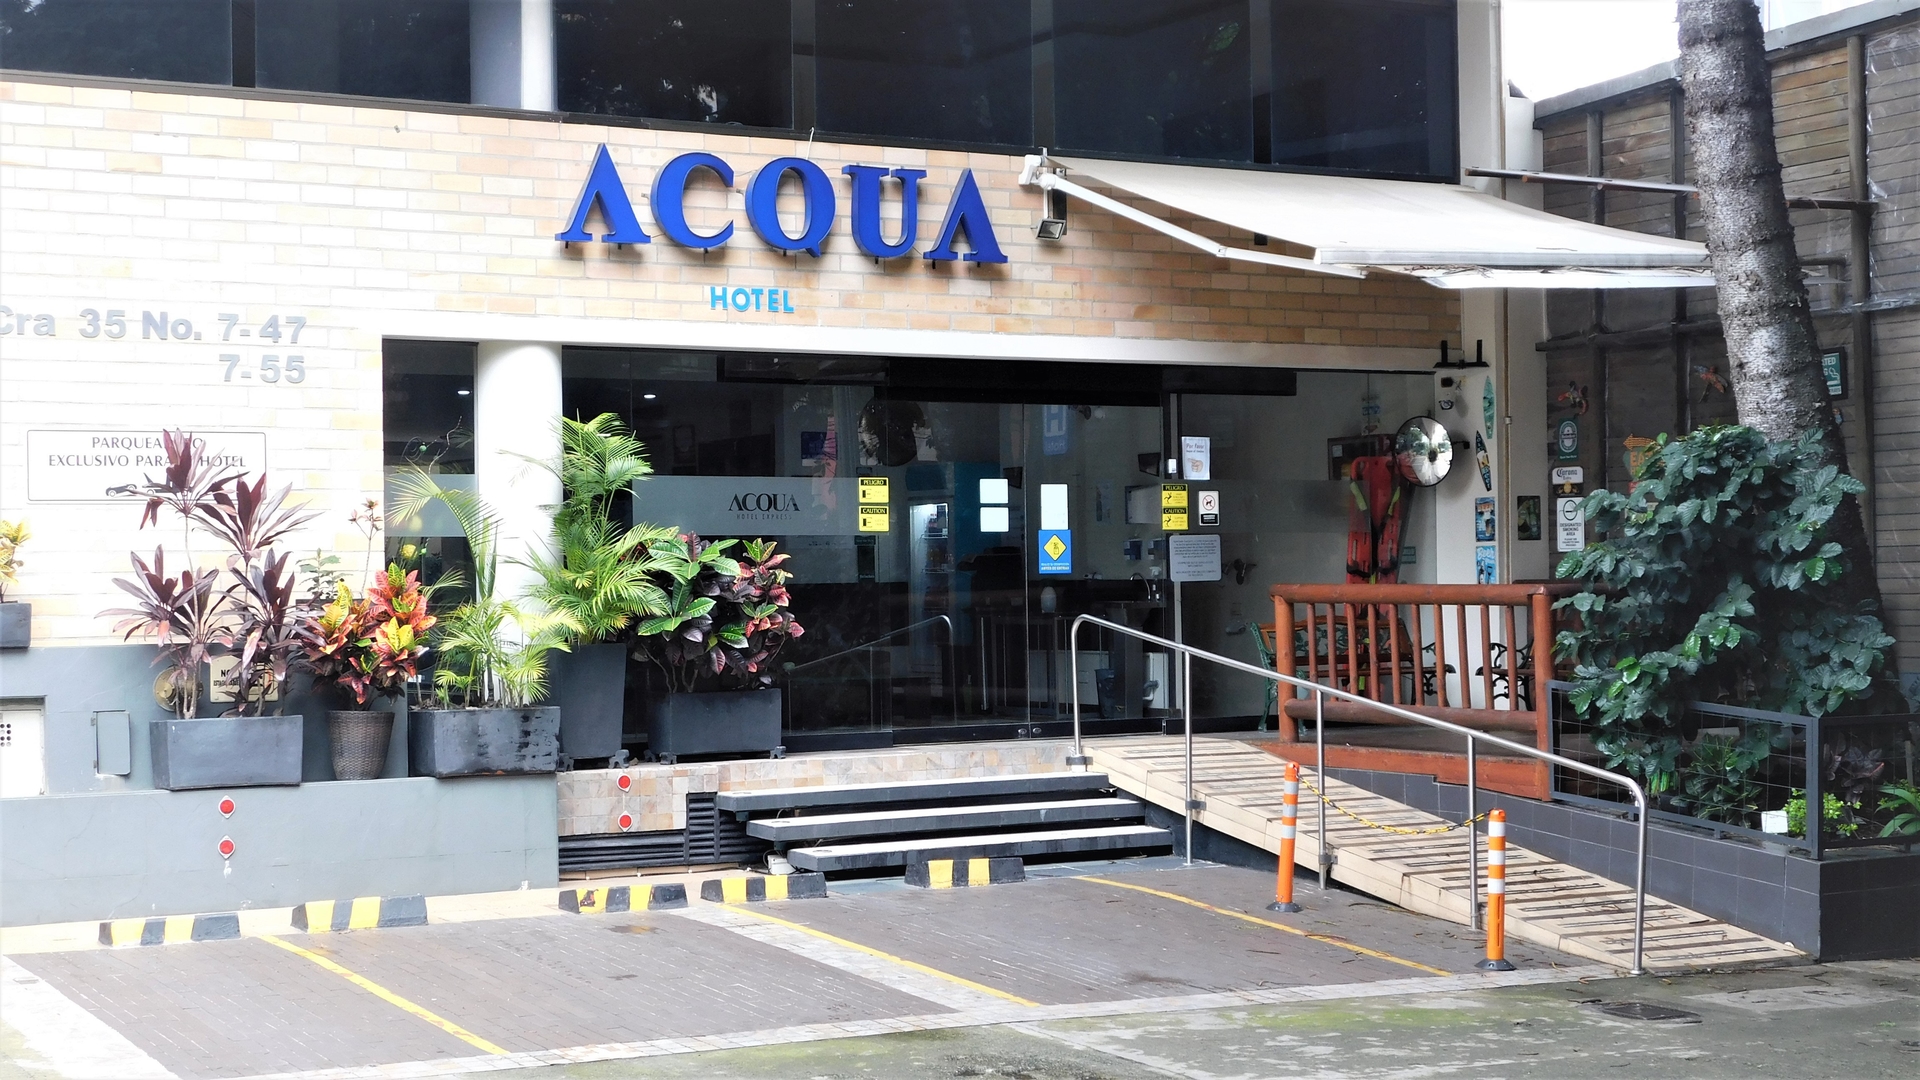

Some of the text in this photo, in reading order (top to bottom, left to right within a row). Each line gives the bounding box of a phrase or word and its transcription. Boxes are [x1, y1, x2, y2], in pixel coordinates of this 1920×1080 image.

[555, 142, 1008, 264] ACQUA
[710, 286, 794, 313] HOTEL
[0, 305, 56, 337] Cra
[79, 308, 127, 338] 35
[142, 311, 202, 340] No.
[219, 354, 306, 384] 7-55
[48, 454, 130, 467] EXCLUSIVO
[727, 492, 801, 512] ACQUA
